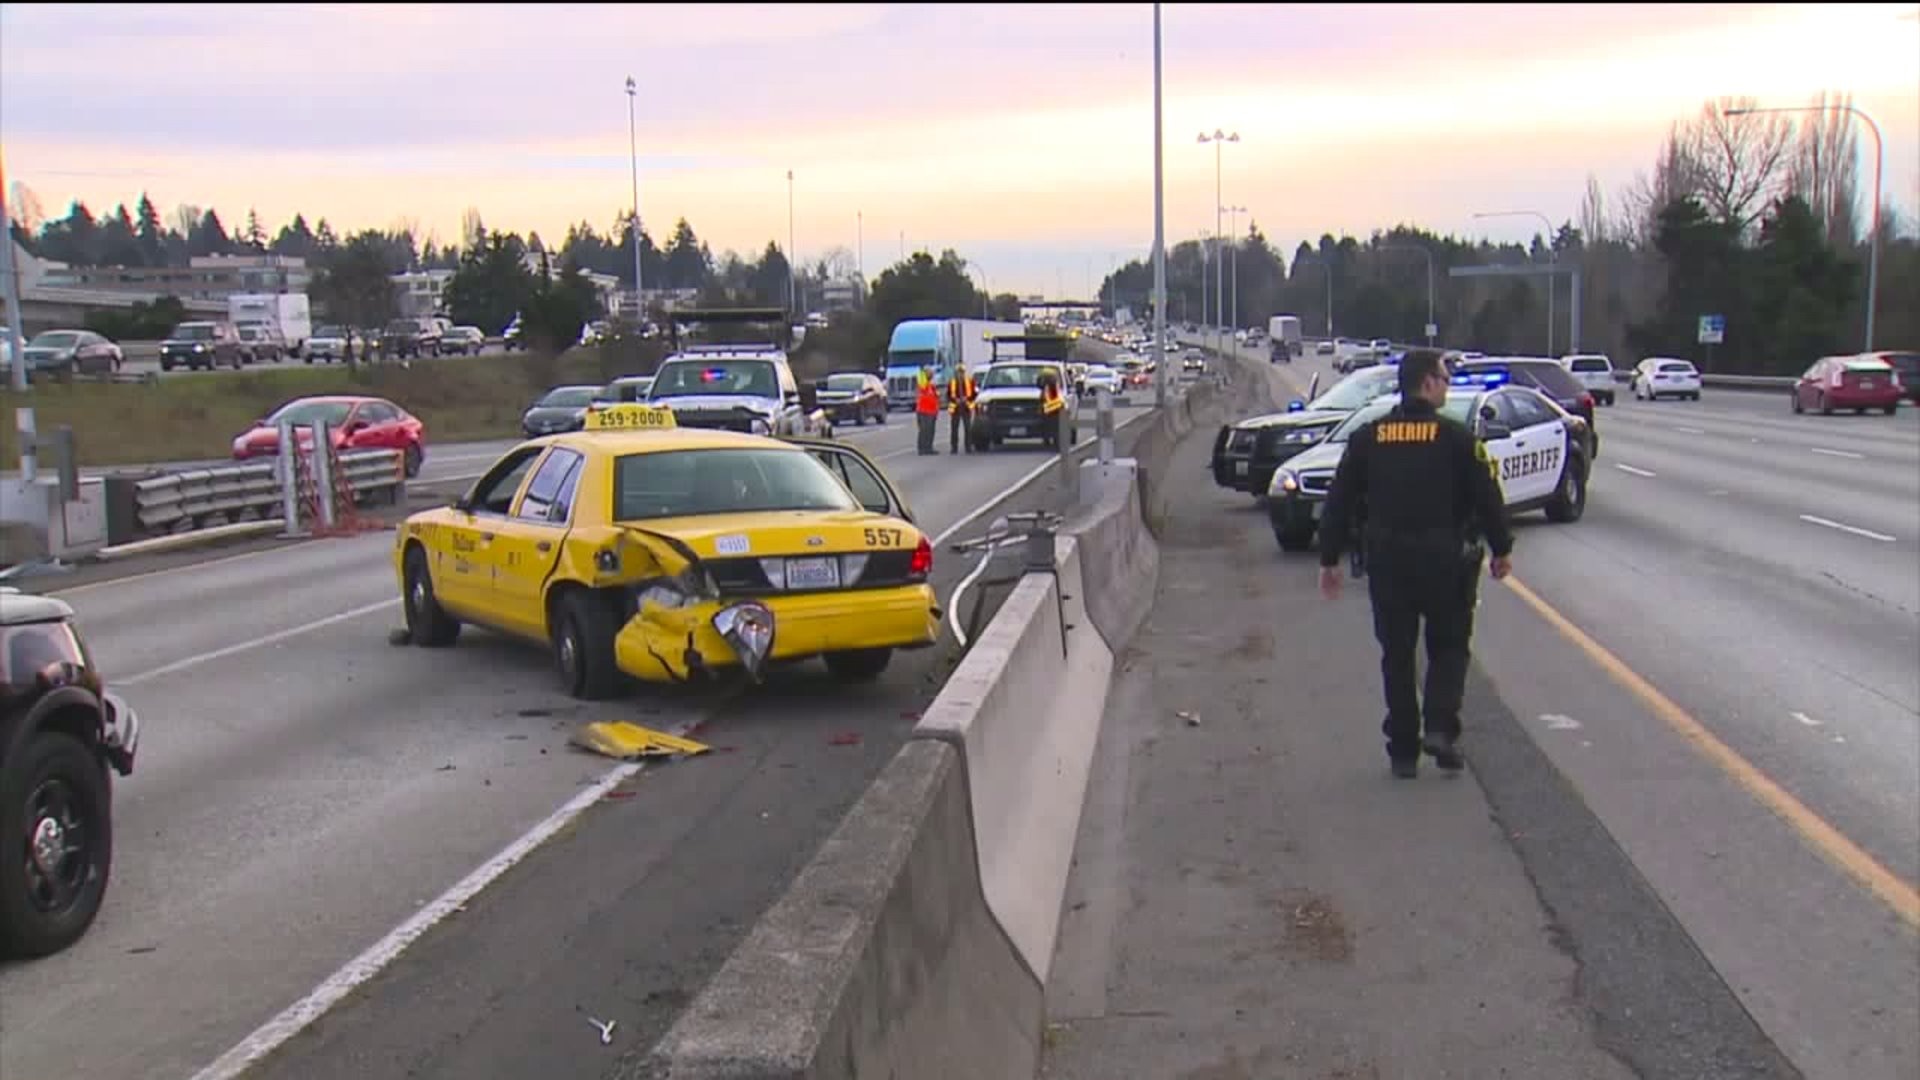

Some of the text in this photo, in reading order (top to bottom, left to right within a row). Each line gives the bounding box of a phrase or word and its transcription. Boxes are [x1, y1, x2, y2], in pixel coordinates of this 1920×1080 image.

[599, 411, 663, 426] 259-2000
[1377, 421, 1438, 443] SHERIFF
[1502, 447, 1560, 481] SHERIFF
[864, 528, 901, 547] 557
